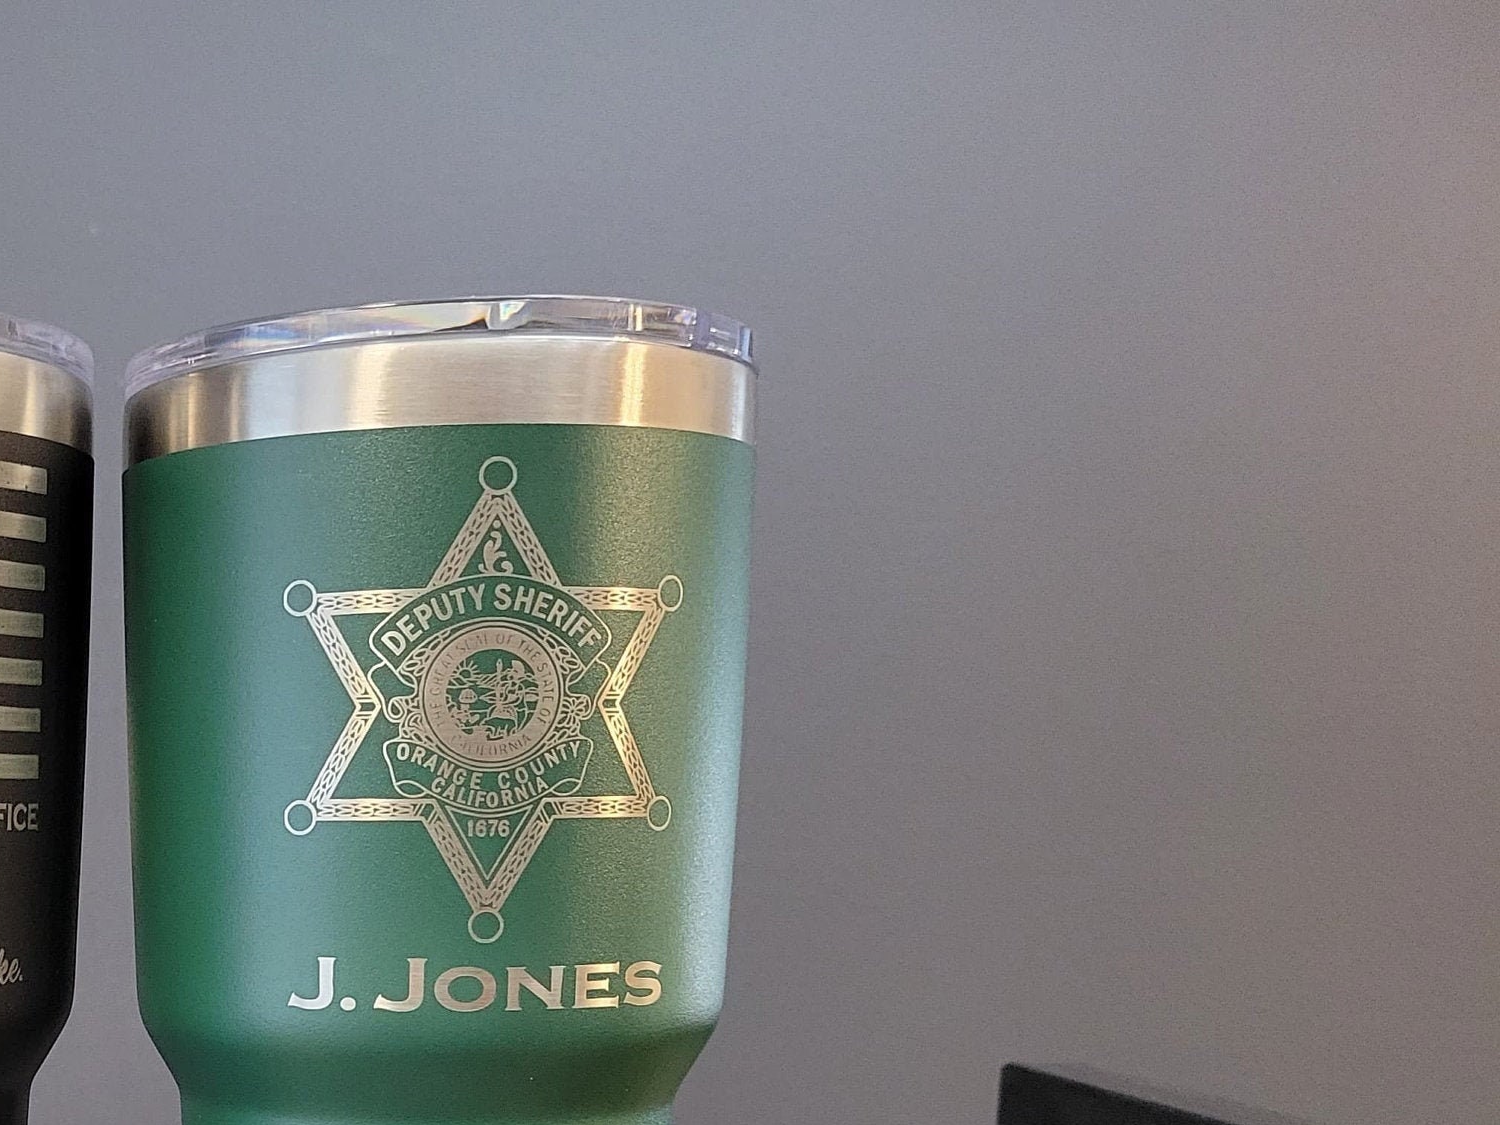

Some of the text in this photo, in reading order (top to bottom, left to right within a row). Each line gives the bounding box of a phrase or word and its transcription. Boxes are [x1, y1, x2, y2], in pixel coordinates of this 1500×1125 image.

[381, 583, 601, 656] DEPUTY SHERIFF
[396, 740, 581, 790] ORANGE COUNTY
[431, 777, 549, 808] CALIFORNIA
[287, 956, 357, 1012] J.
